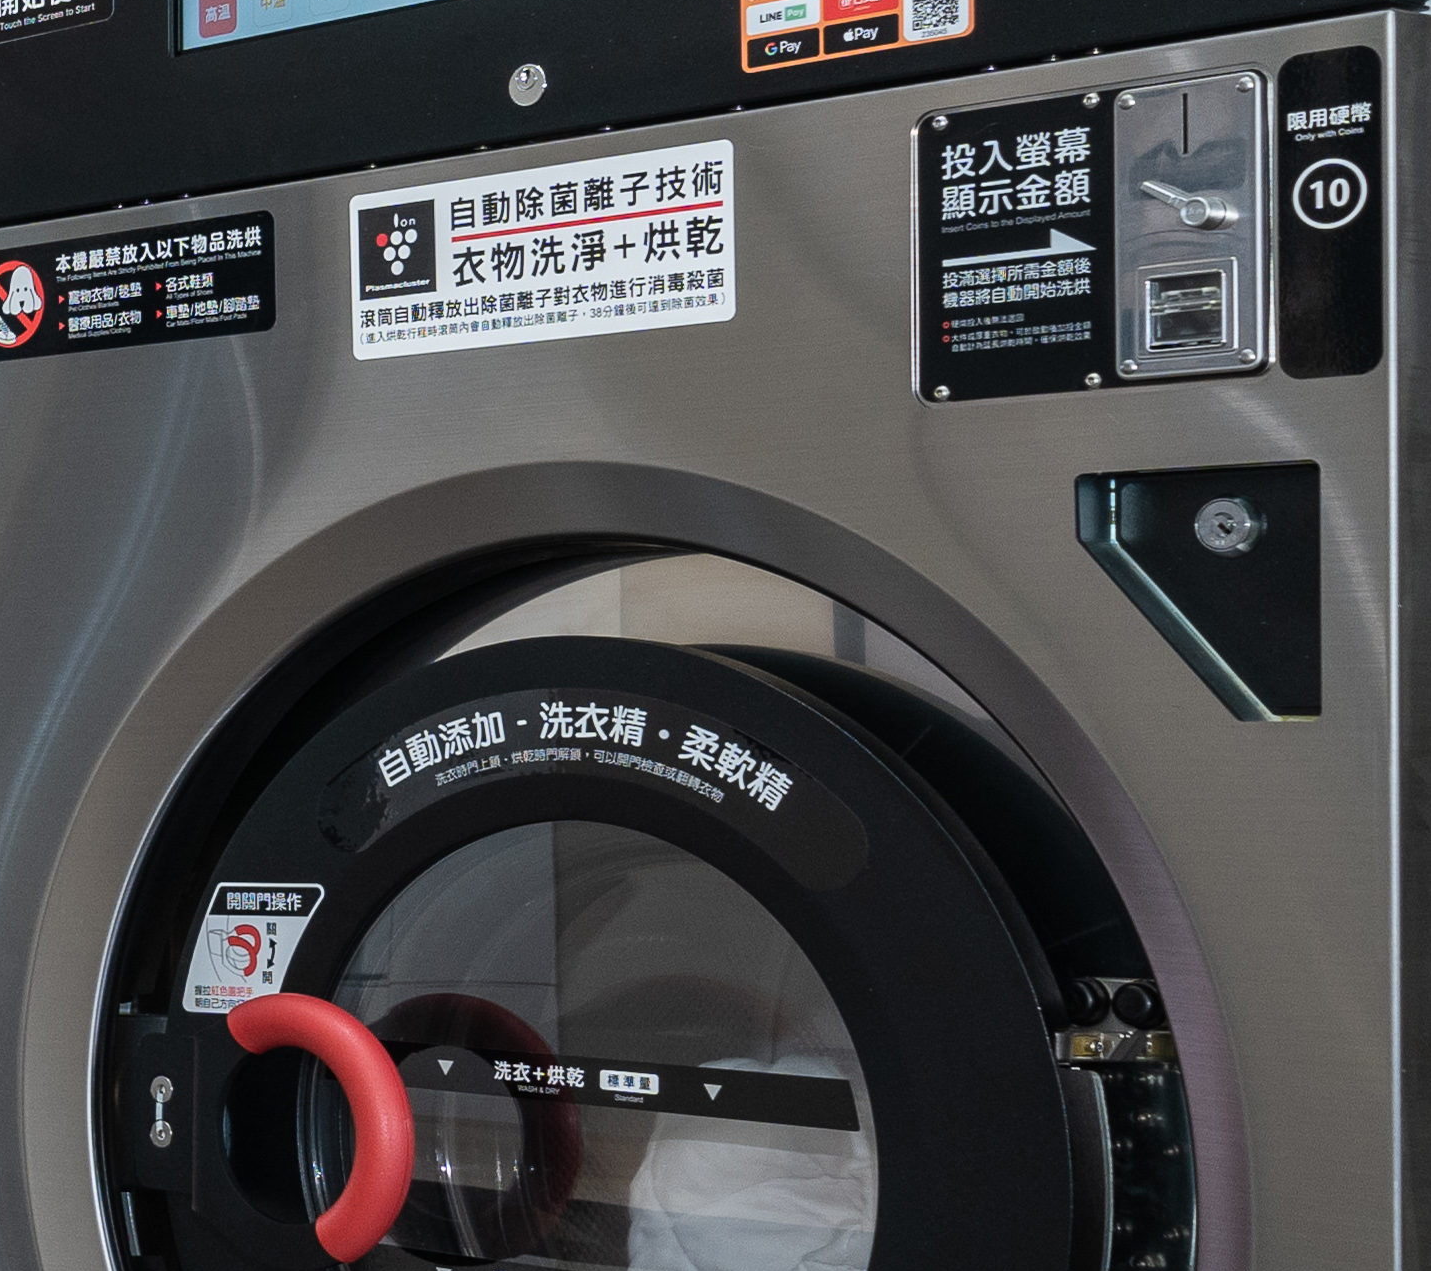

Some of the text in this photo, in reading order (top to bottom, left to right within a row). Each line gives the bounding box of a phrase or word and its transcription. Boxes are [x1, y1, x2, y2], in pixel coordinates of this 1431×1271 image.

[0, 2, 95, 32] Touch Screen Start
[760, 7, 804, 23] LINE Pay
[854, 27, 879, 41] Pay
[779, 40, 802, 54] Pay
[1287, 101, 1372, 131] 限用硬幣
[1295, 126, 1364, 143] Only Coins
[941, 126, 1091, 181] 投入螢幕
[450, 160, 723, 231] 自動除菌離子技術
[941, 169, 1091, 221] 顯示金額
[1309, 178, 1351, 210] 10
[966, 209, 1091, 231] Coins Displayed Amount
[56, 226, 262, 273] 本機嚴禁放入以下物品洗烘
[165, 272, 214, 293] 各式鞋類
[942, 257, 1091, 289] 投滿選擇所需金額後
[365, 278, 431, 293] Plasmacluster
[942, 278, 1091, 309] 機器將自動開始洗烘
[68, 310, 141, 333] 醫療用品/衣物
[227, 892, 302, 912] 開關門操作
[494, 1060, 585, 1088] 洗衣+烘乾
[517, 1084, 559, 1095] WASH DRY
[614, 1094, 644, 1103] Standard
